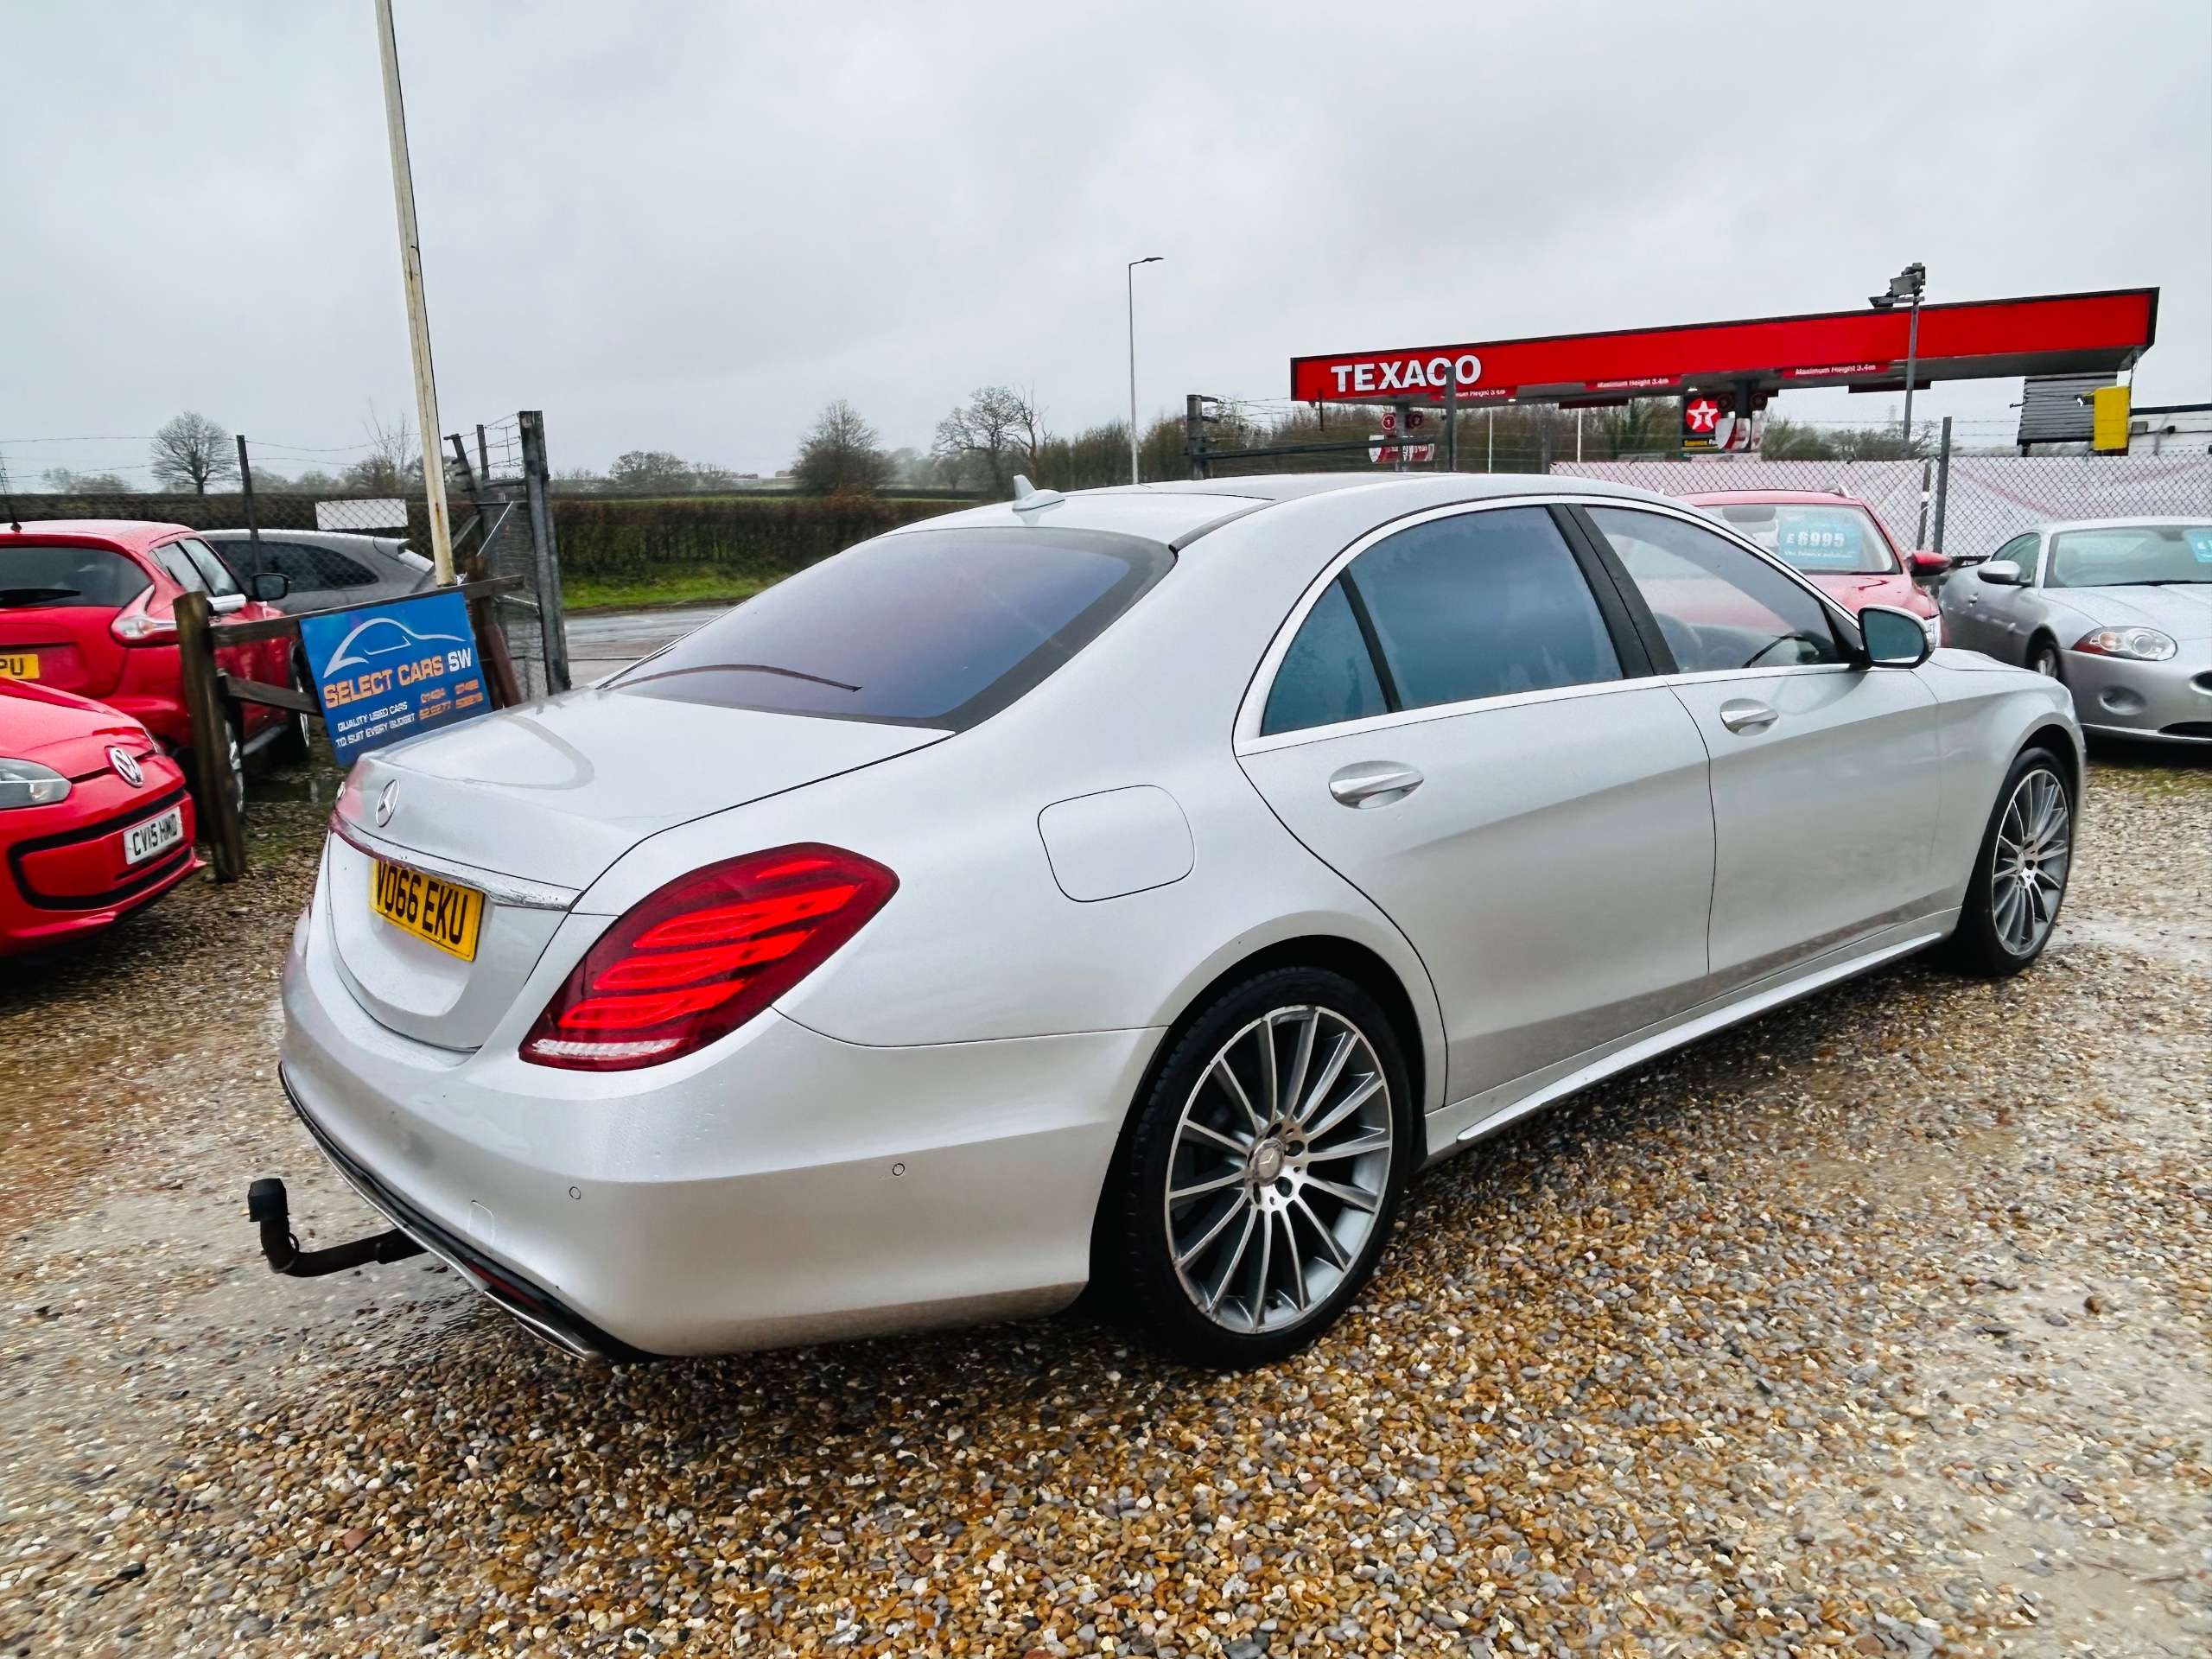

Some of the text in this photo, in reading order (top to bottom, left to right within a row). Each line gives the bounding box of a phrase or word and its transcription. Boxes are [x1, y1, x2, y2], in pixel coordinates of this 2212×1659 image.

[1331, 354, 1482, 392] TEXACO
[1831, 365, 1856, 374] Height
[323, 647, 472, 709] SELECT CARS SW
[335, 713, 415, 747] TO SUIT EVERY BUDGET
[337, 701, 408, 732] QUALITY USED CARS
[132, 823, 158, 856] CV15
[422, 880, 468, 944] EKU
